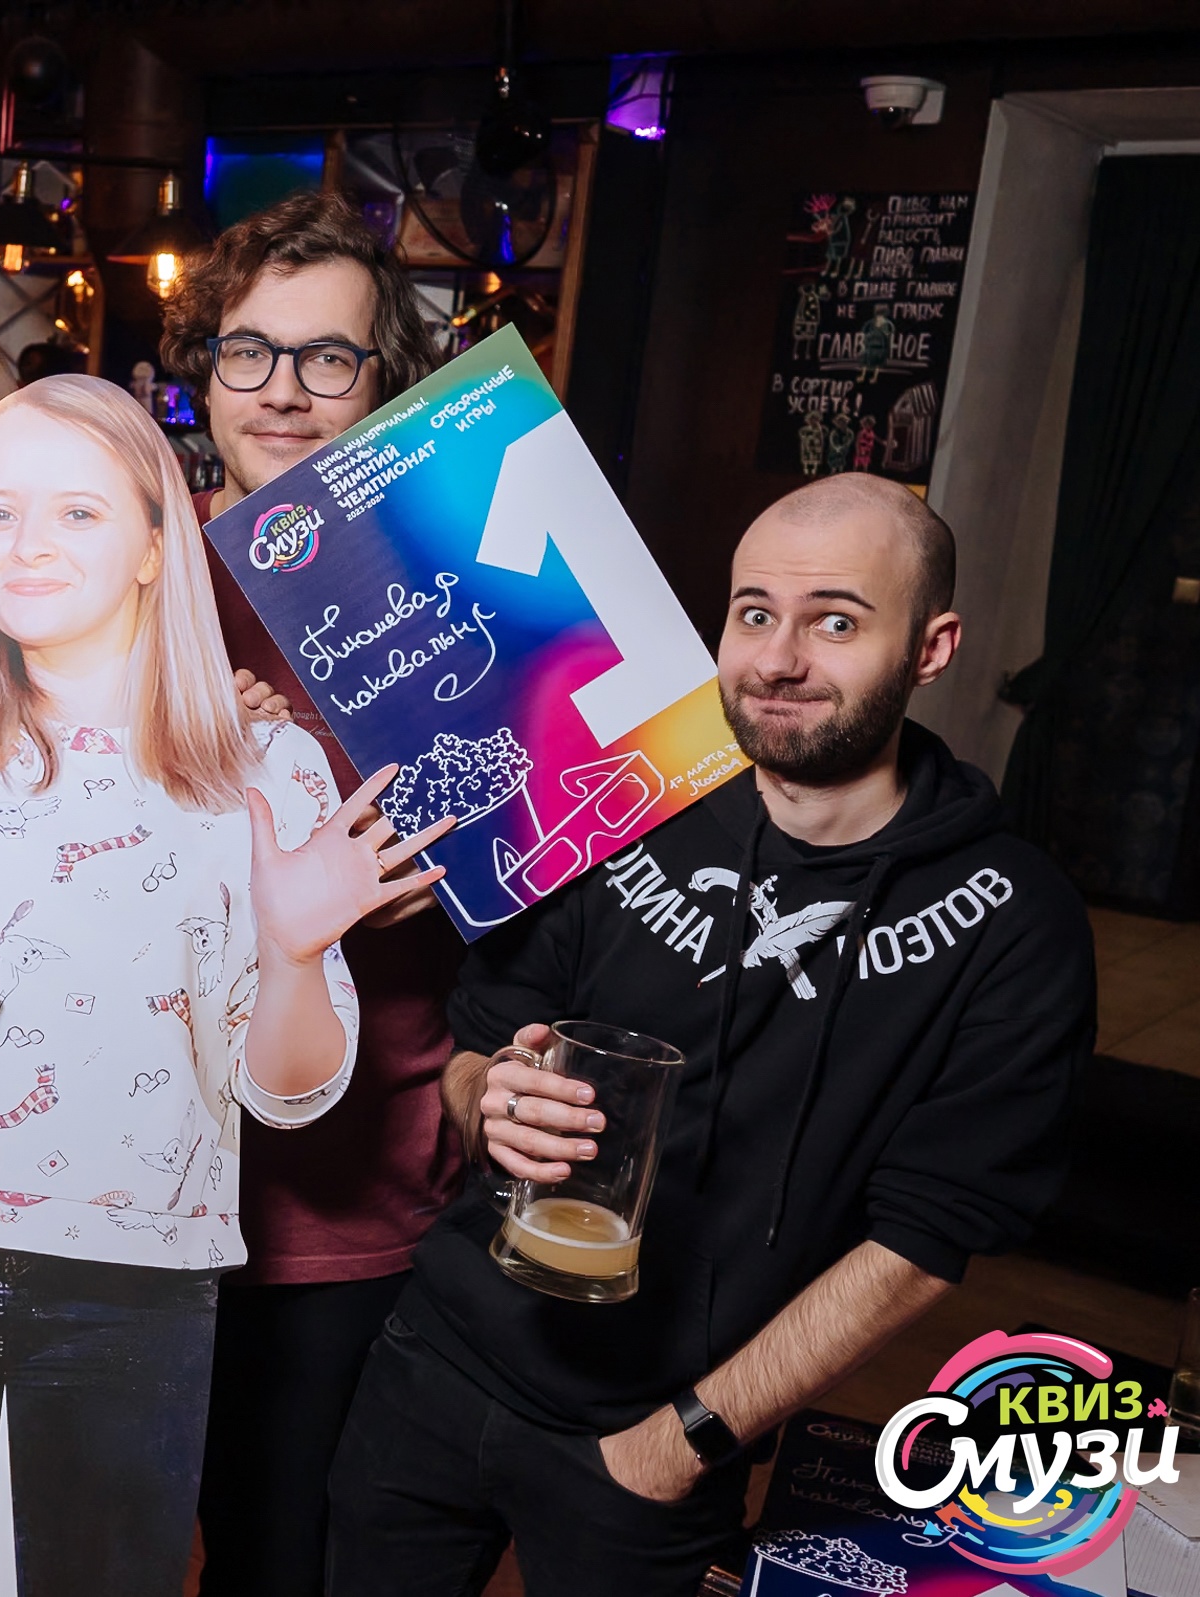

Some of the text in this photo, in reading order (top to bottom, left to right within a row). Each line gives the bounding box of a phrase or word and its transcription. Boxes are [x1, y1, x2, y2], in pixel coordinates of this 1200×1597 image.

[939, 195, 968, 209] НАМ
[881, 212, 957, 230] ПРИНОСИТ
[873, 245, 914, 263] ПИВО
[837, 282, 848, 297] В
[853, 280, 897, 299] ПИВЕ
[837, 302, 944, 321] НЕ ГРАДУС
[430, 364, 515, 429] ОТБОРОЧНЫЕ
[772, 373, 854, 396] В СОРТИР
[454, 398, 497, 432] ИГРЫ
[329, 443, 401, 498] ЗИМНИЙ
[337, 440, 437, 509] ЧЕМПИОНАТ
[269, 504, 307, 536] КВИЗ
[346, 492, 386, 522] 2023-2024
[248, 509, 325, 570] Смузи
[476, 409, 719, 750] 1
[299, 572, 459, 681] Плюшевая
[669, 775, 685, 790] 17
[686, 750, 728, 780] МАРТА
[604, 842, 715, 964] ОДИНА
